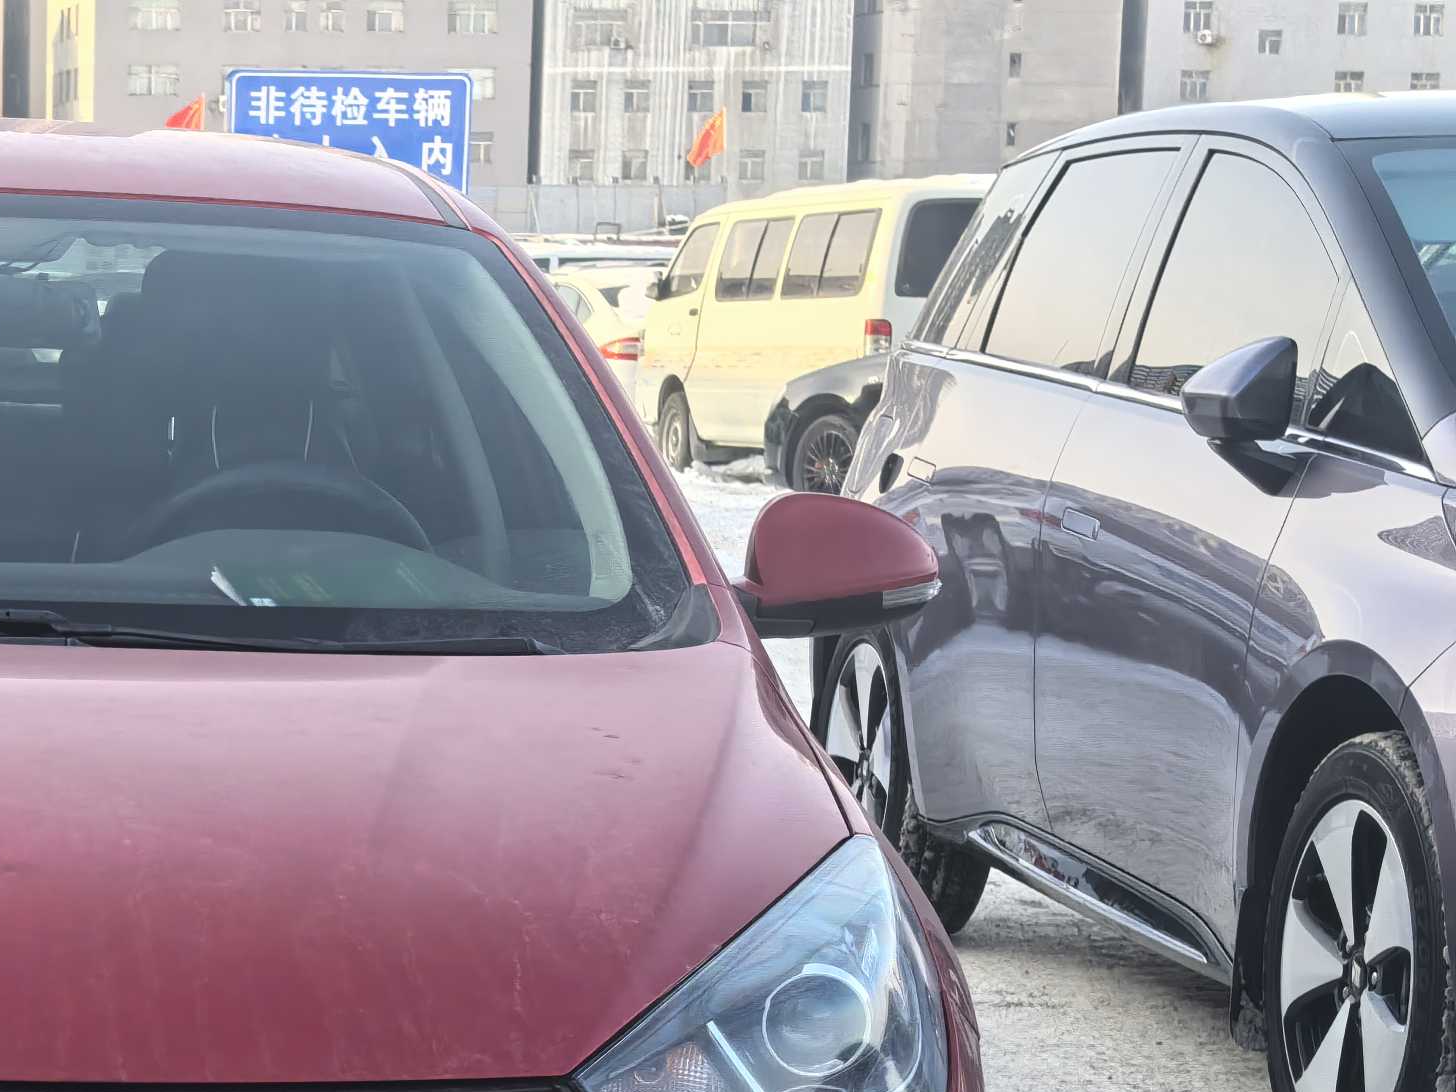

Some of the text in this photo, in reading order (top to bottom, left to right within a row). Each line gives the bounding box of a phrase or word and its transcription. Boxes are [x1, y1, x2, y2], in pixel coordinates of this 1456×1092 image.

[248, 85, 452, 127] 非待检车辆
